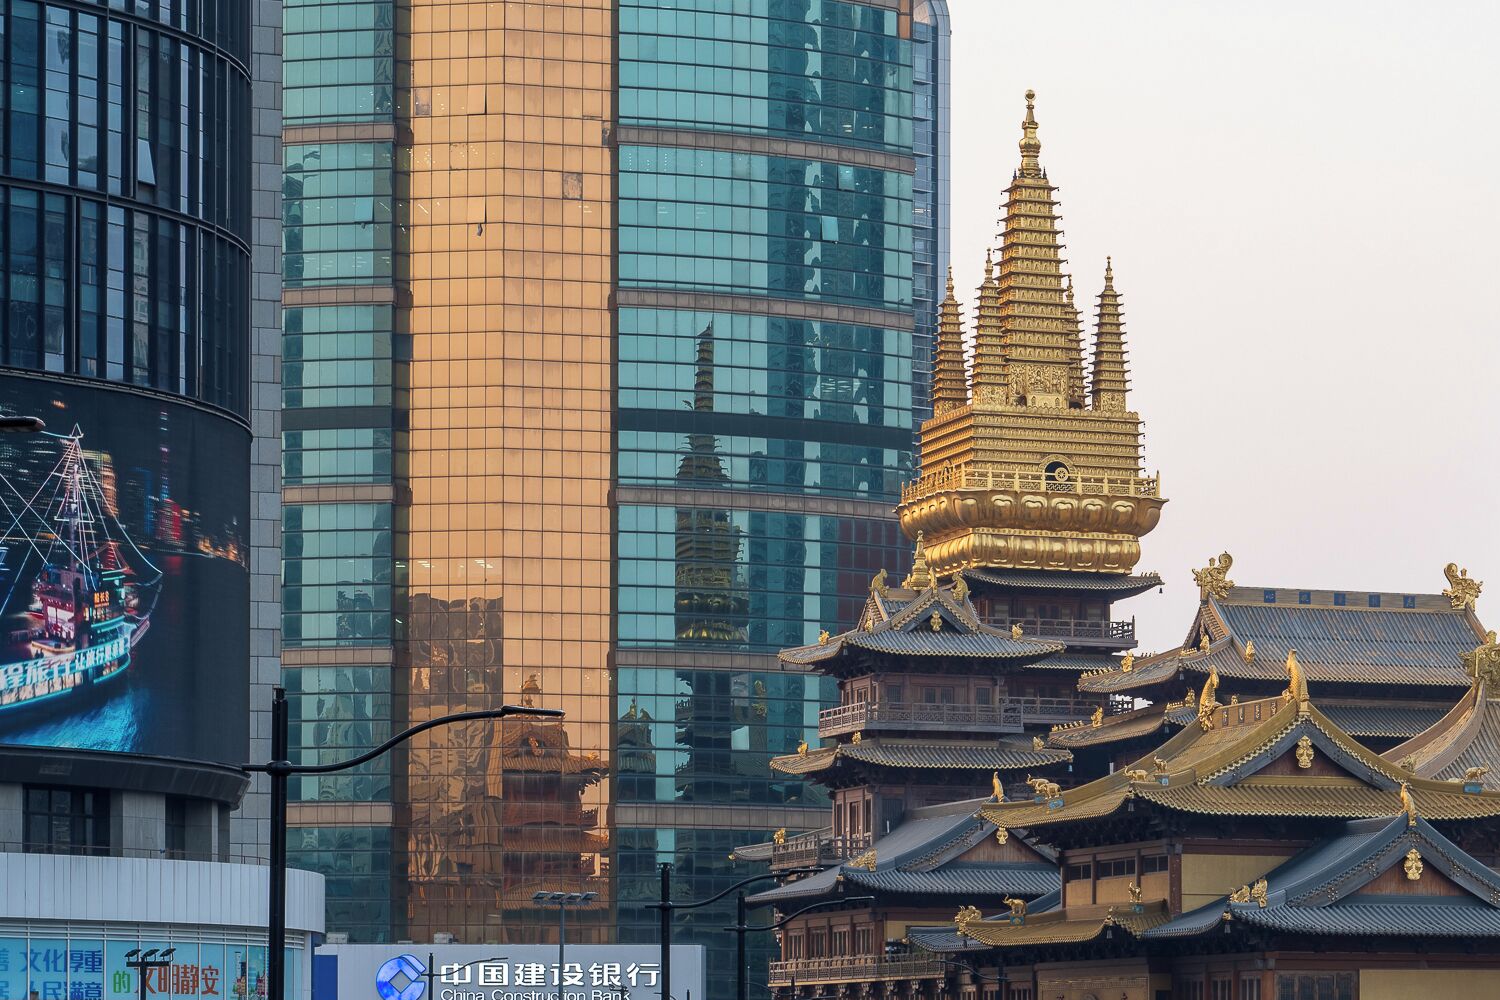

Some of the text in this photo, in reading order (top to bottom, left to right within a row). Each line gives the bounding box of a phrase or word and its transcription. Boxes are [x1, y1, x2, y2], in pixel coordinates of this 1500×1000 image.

[21, 949, 103, 974] 文化厚重
[440, 961, 660, 987] 中国建设银行
